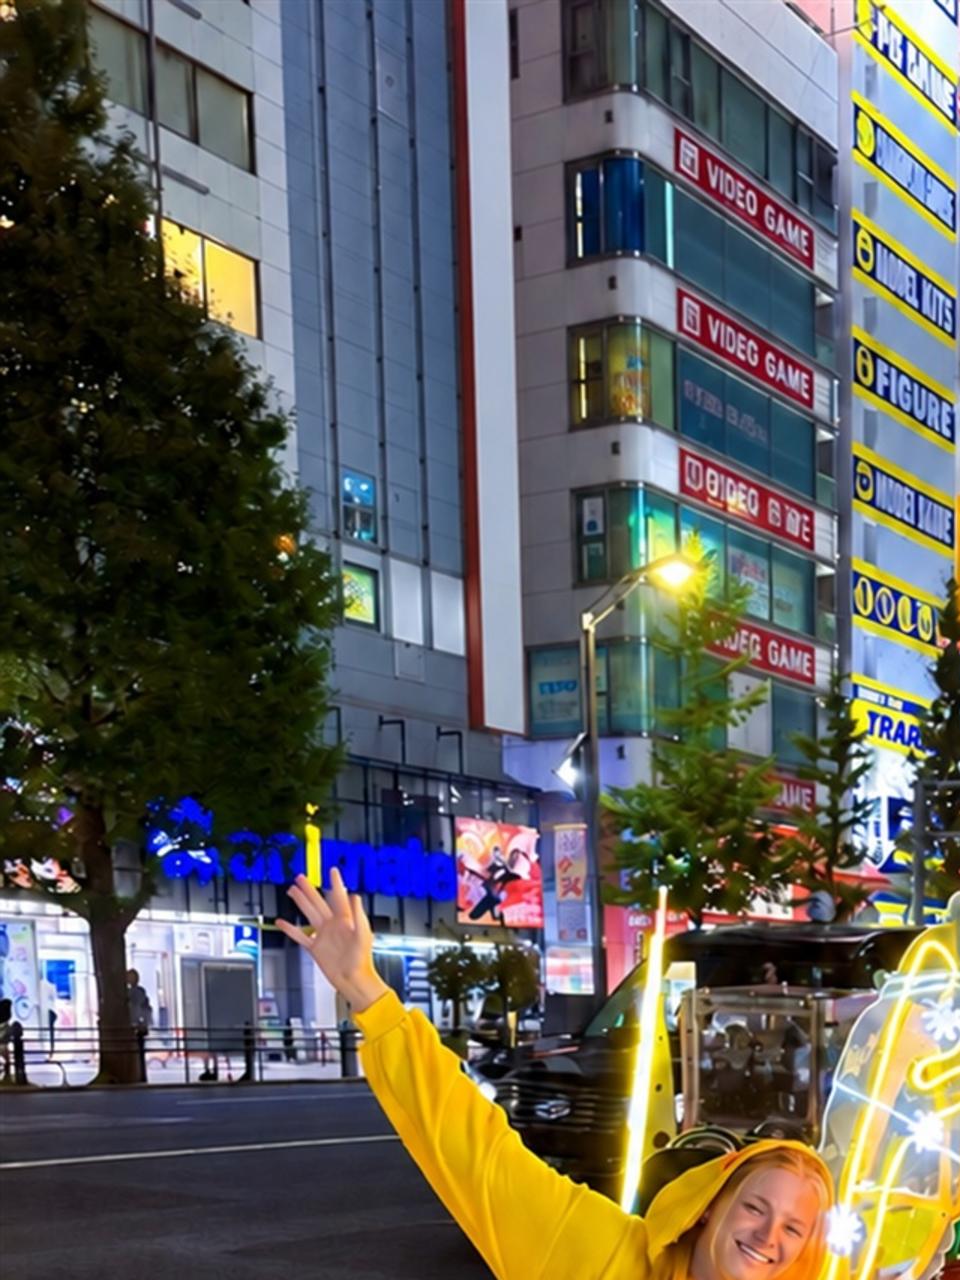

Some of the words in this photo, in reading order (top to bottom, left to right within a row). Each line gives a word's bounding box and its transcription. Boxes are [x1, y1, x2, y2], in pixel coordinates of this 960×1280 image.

[706, 158, 758, 217] VIDEO
[763, 204, 811, 258] GAME
[765, 351, 811, 401] GAME
[875, 357, 953, 439] FIGURE
[767, 639, 813, 677] GAME
[776, 781, 813, 812] AME
